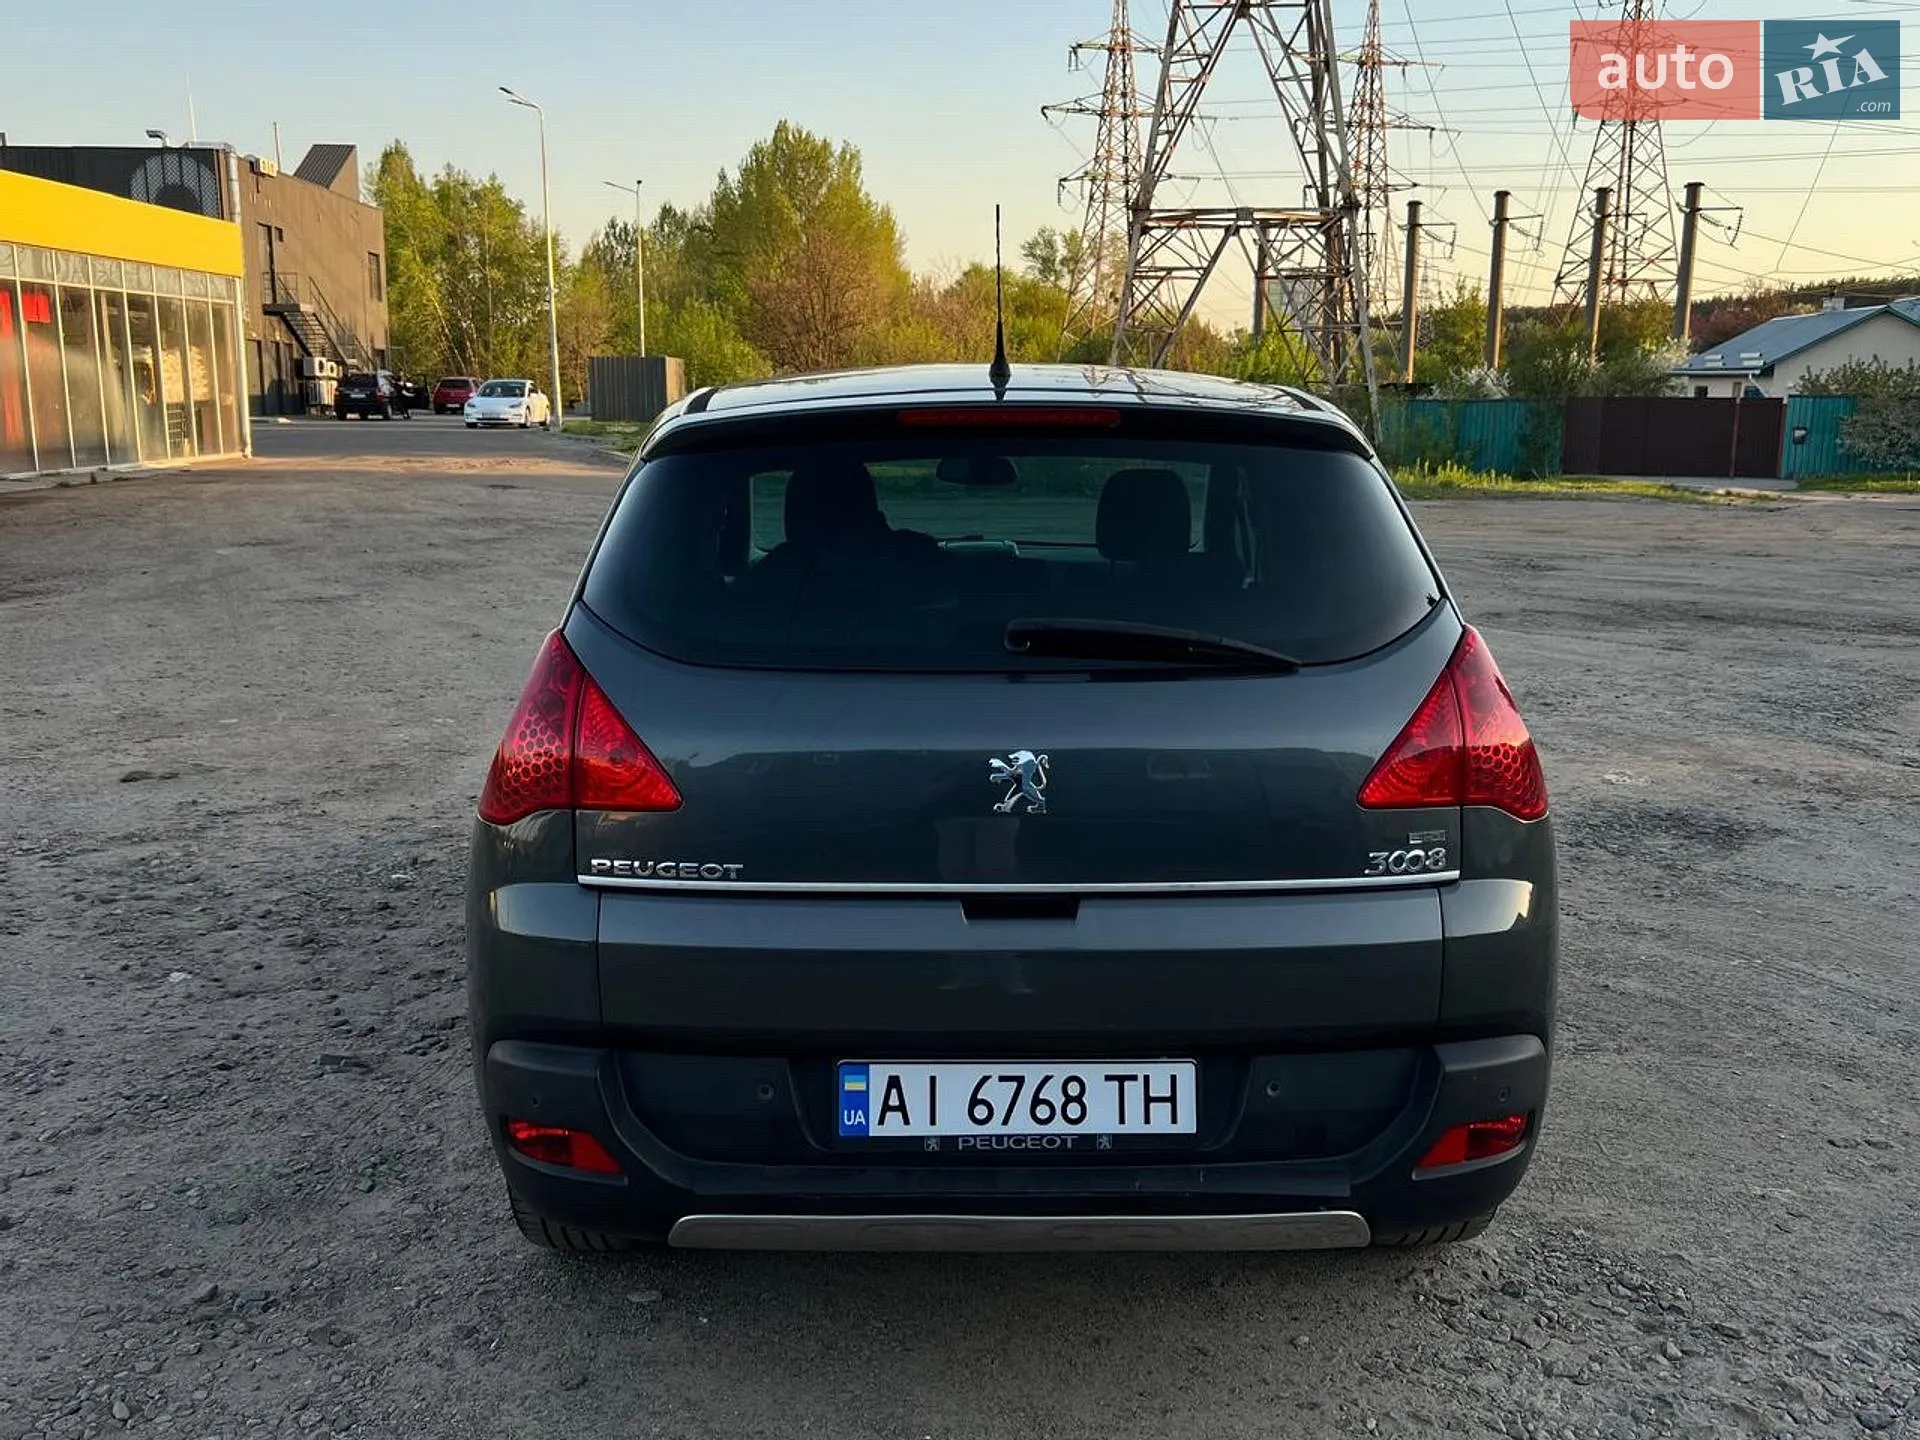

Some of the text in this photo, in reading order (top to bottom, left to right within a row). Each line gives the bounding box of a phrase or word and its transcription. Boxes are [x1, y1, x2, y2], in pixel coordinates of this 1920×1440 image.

[590, 858, 744, 880] PEUGEOT
[1364, 847, 1446, 876] 3008
[877, 1073, 1178, 1126] AI 6768 TH
[844, 1110, 866, 1125] UA
[958, 1135, 1079, 1150] PEUGEOT
